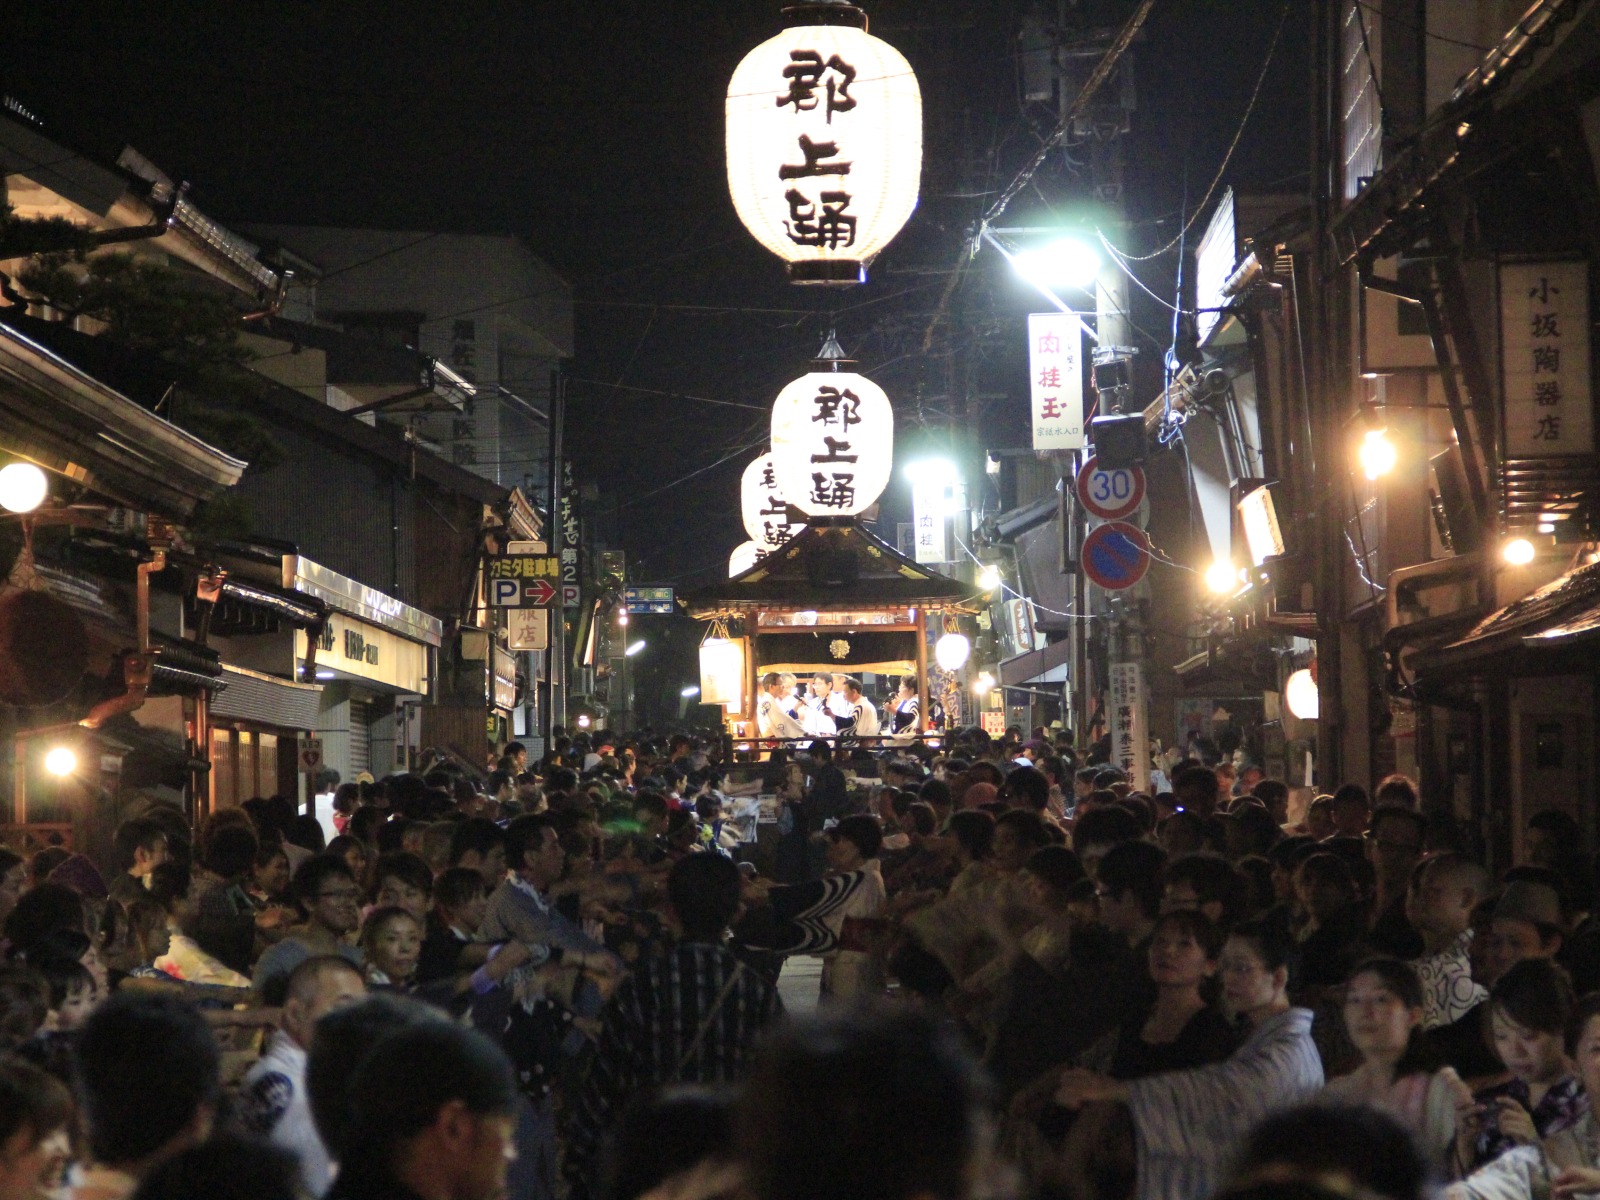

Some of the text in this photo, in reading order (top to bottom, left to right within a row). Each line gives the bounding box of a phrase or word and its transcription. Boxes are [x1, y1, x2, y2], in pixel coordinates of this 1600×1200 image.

[775, 48, 858, 251] 郡上踊
[1037, 330, 1067, 420] 肉桂玉
[1529, 277, 1562, 441] 小坂陶器店
[809, 385, 862, 509] 郡上踊
[1092, 470, 1130, 503] 30
[490, 558, 559, 578] カミタ駐車場
[496, 580, 518, 605] P
[564, 588, 578, 605] P
